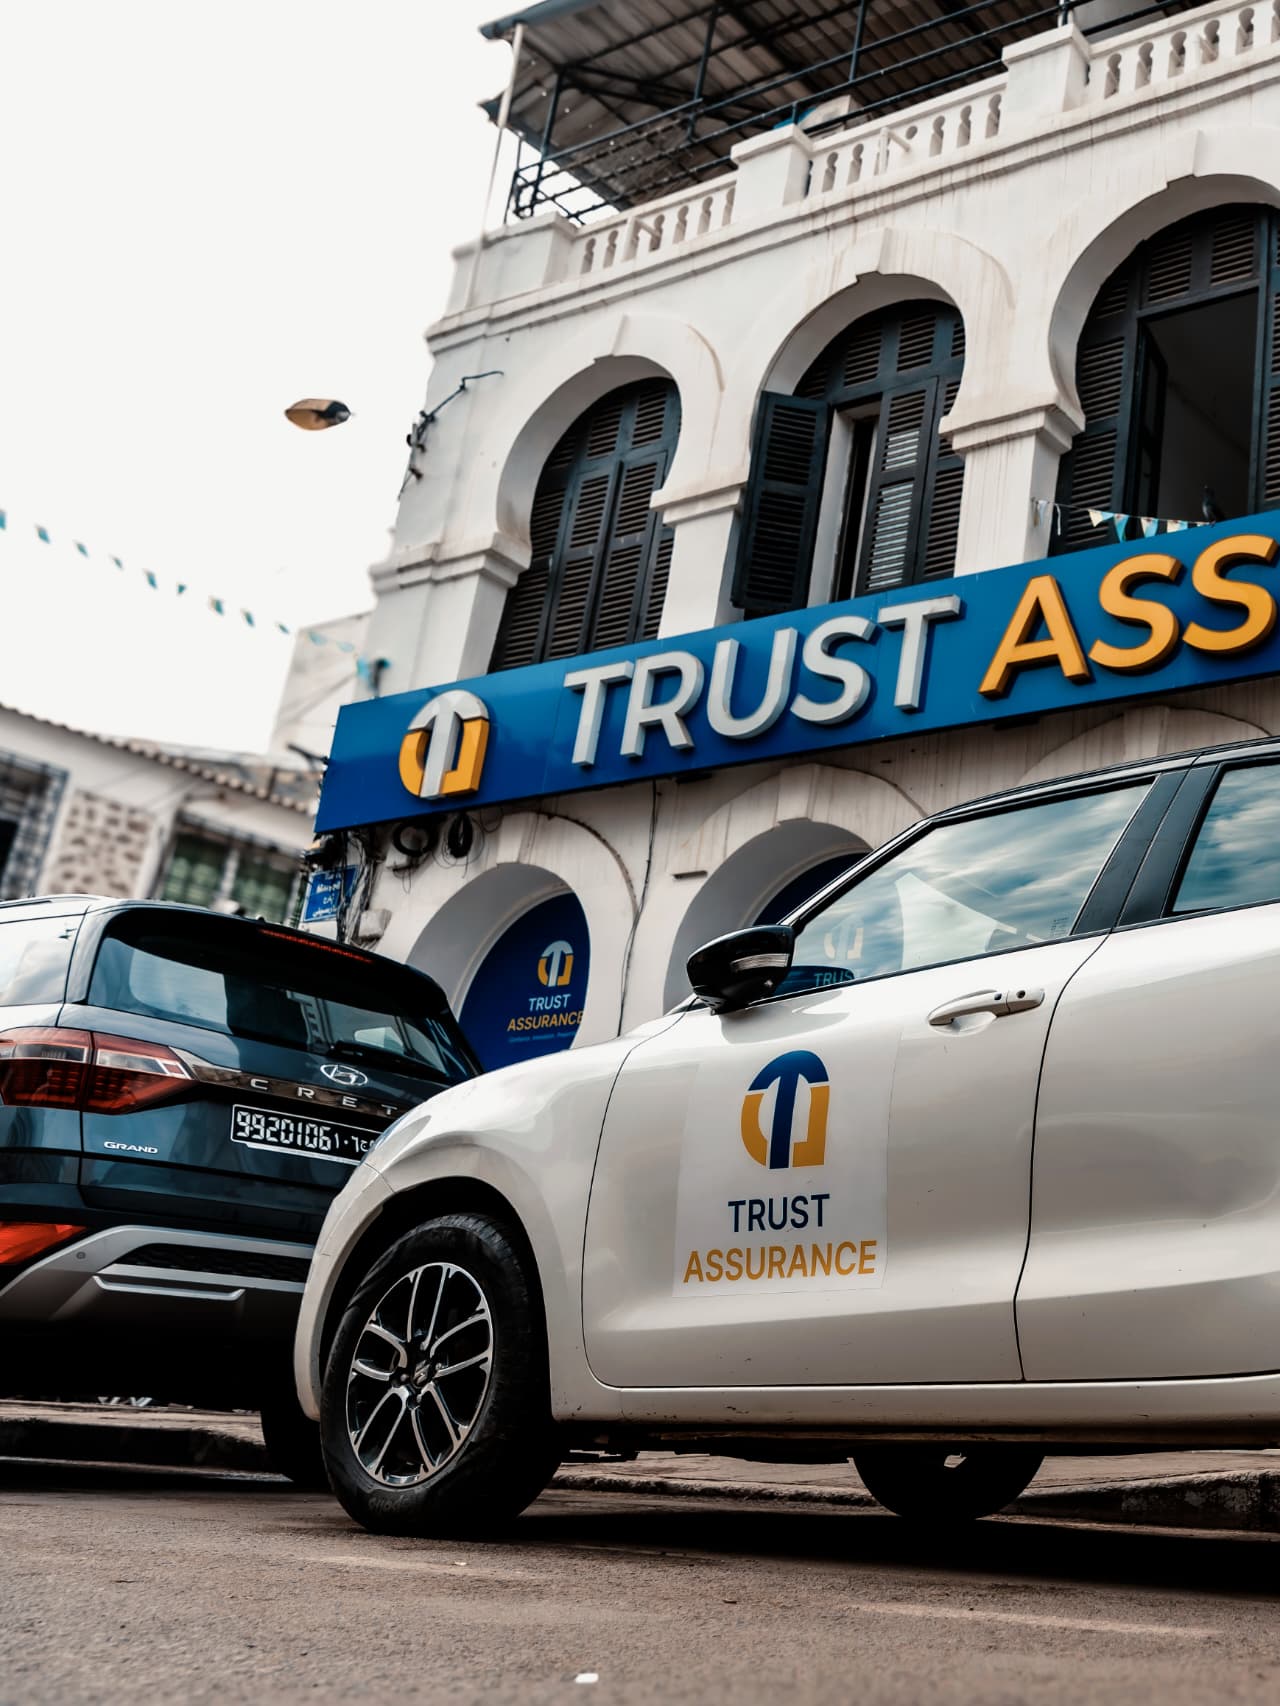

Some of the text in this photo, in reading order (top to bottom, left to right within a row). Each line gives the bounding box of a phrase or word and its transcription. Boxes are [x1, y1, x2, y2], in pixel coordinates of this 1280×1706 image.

[564, 594, 961, 766] TRUST
[529, 993, 571, 1012] TRUST
[507, 1010, 584, 1032] ASSURANCE
[103, 1140, 159, 1155] GRAND
[727, 1193, 830, 1233] TRUST
[683, 1240, 877, 1284] ASSURANCE
